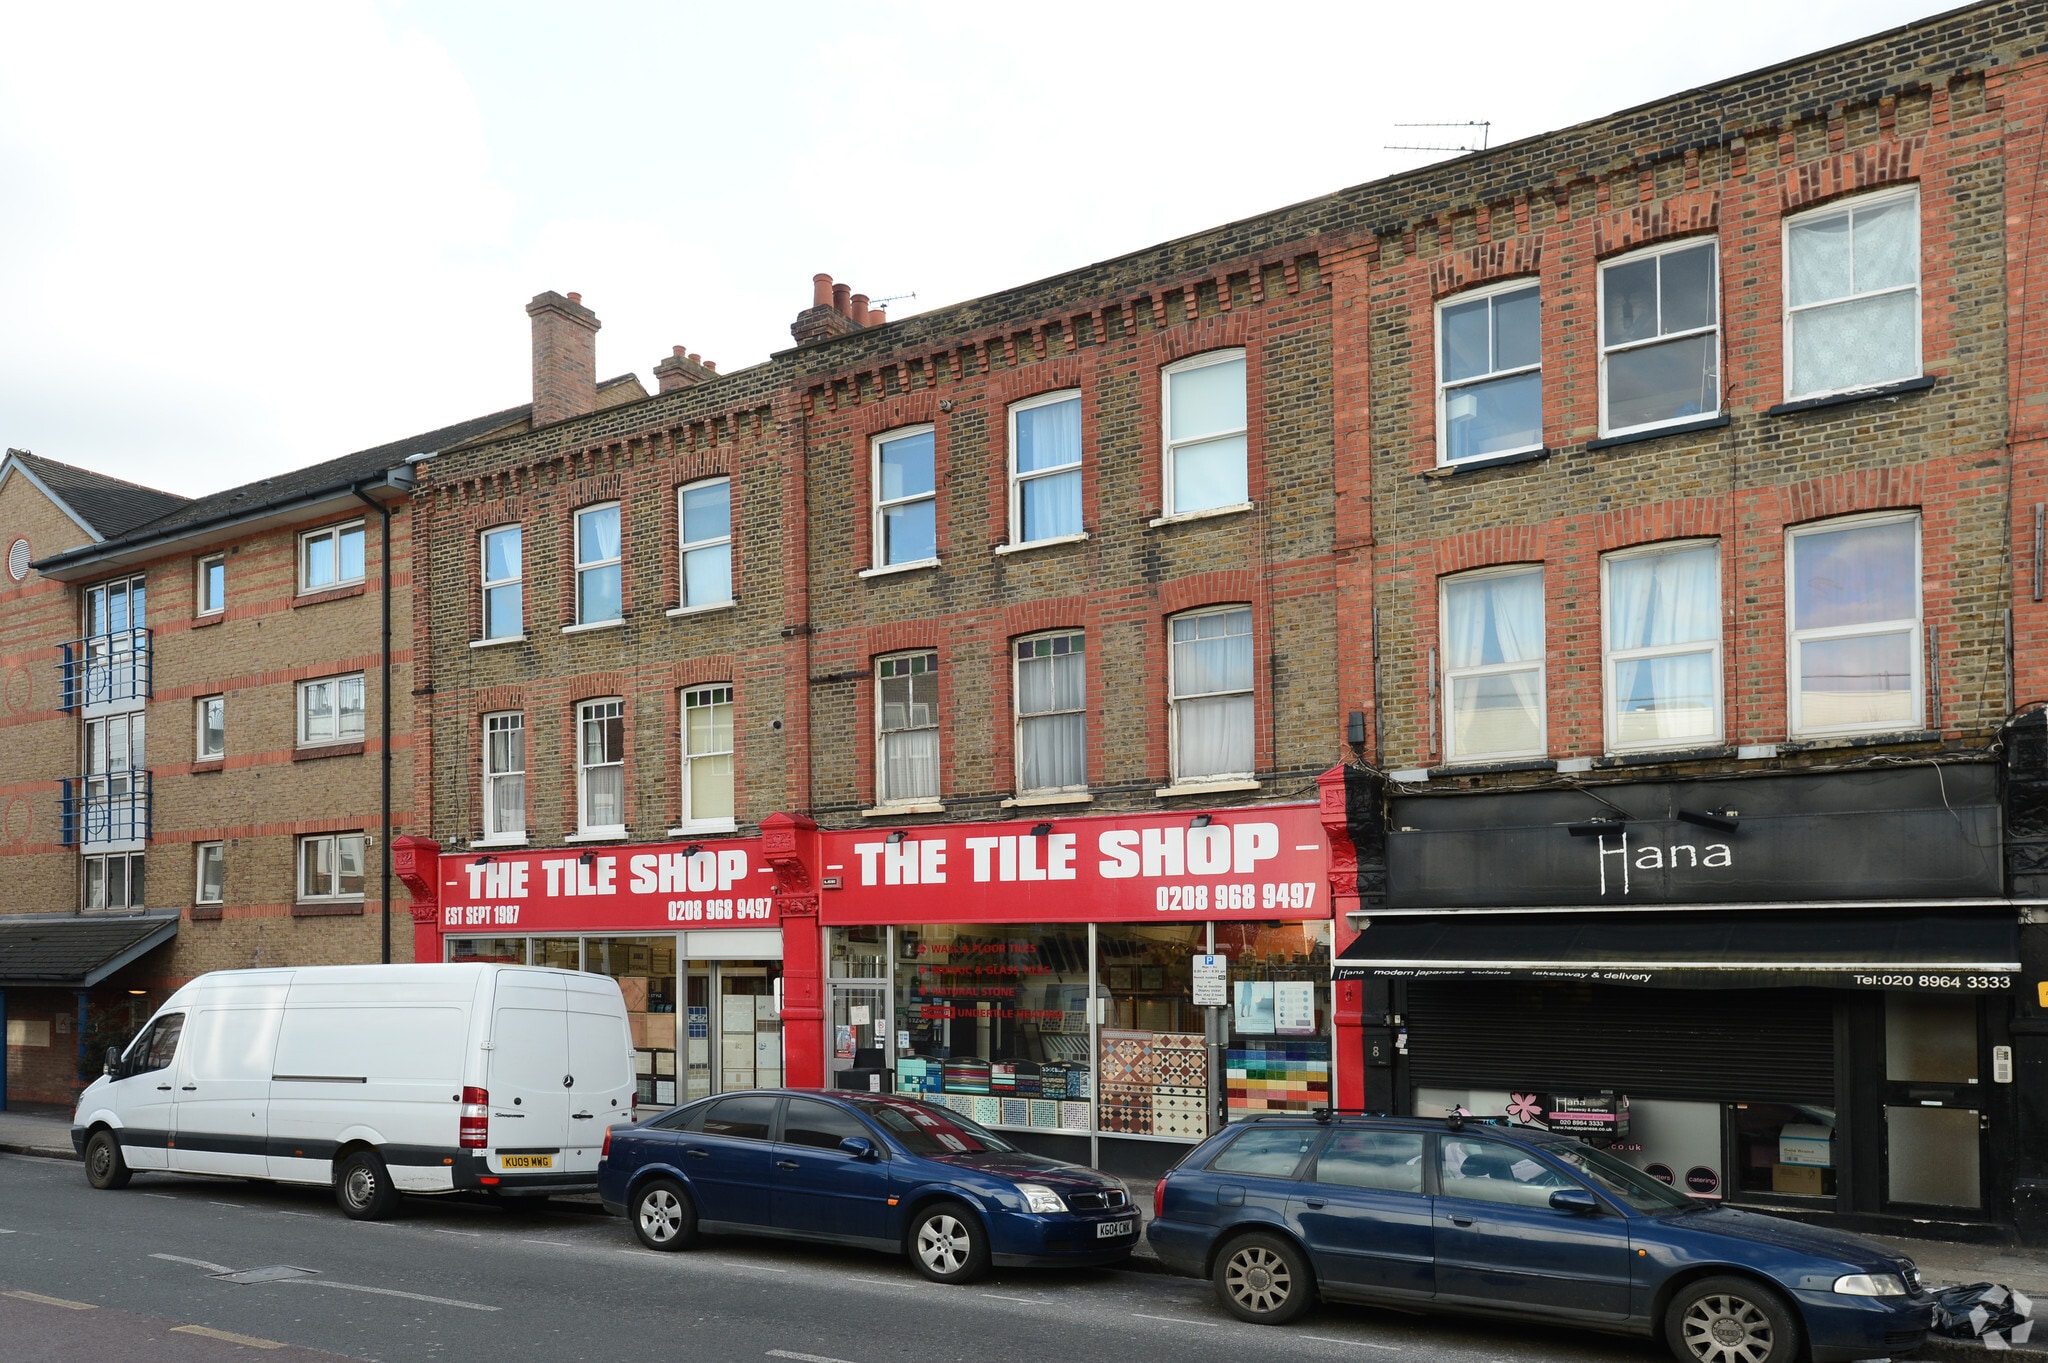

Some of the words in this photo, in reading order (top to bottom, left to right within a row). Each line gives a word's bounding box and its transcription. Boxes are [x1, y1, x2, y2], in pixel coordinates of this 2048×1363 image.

[854, 839, 946, 886] THE
[965, 833, 1076, 882] TILE
[1098, 822, 1279, 878] SHOP
[1599, 832, 1732, 895] Hana
[465, 861, 529, 899] THE
[542, 856, 617, 897] TILE
[629, 850, 748, 894] SHOP
[1156, 886, 1207, 911] 0208
[1215, 884, 1255, 910] 968
[1262, 882, 1316, 909] 9497
[445, 906, 463, 925] EST
[465, 905, 491, 925] SEPT
[494, 905, 520, 925] 1987
[667, 900, 702, 921] 0208
[706, 899, 733, 920] 968
[737, 898, 772, 919] 9497
[931, 944, 958, 953] WALL
[962, 944, 969, 953] &
[973, 944, 1006, 953] FLOOR
[1009, 943, 1037, 953] TILES
[931, 966, 972, 975] MOSAIC
[975, 966, 983, 975] &
[986, 966, 1019, 975] GLASS
[1023, 966, 1051, 975] TILES
[1338, 969, 1365, 980] Hana
[1415, 969, 1465, 977] japanese
[1532, 971, 1588, 979] takeaway
[1591, 971, 1600, 979] &
[1603, 972, 1652, 983] delivery
[1853, 975, 1914, 986] Tel:020
[1918, 975, 1961, 988] 8964
[1967, 976, 2011, 989] 3333
[931, 987, 978, 997] NATURAL
[981, 987, 1015, 997] STONE
[957, 1009, 1014, 1019] UNDERTILE
[1016, 1010, 1064, 1019] HEATING
[1372, 1046, 1380, 1057] 8
[505, 1157, 529, 1167] KU09
[1688, 1176, 1716, 1184] catering
[1100, 1222, 1118, 1236] KG04
